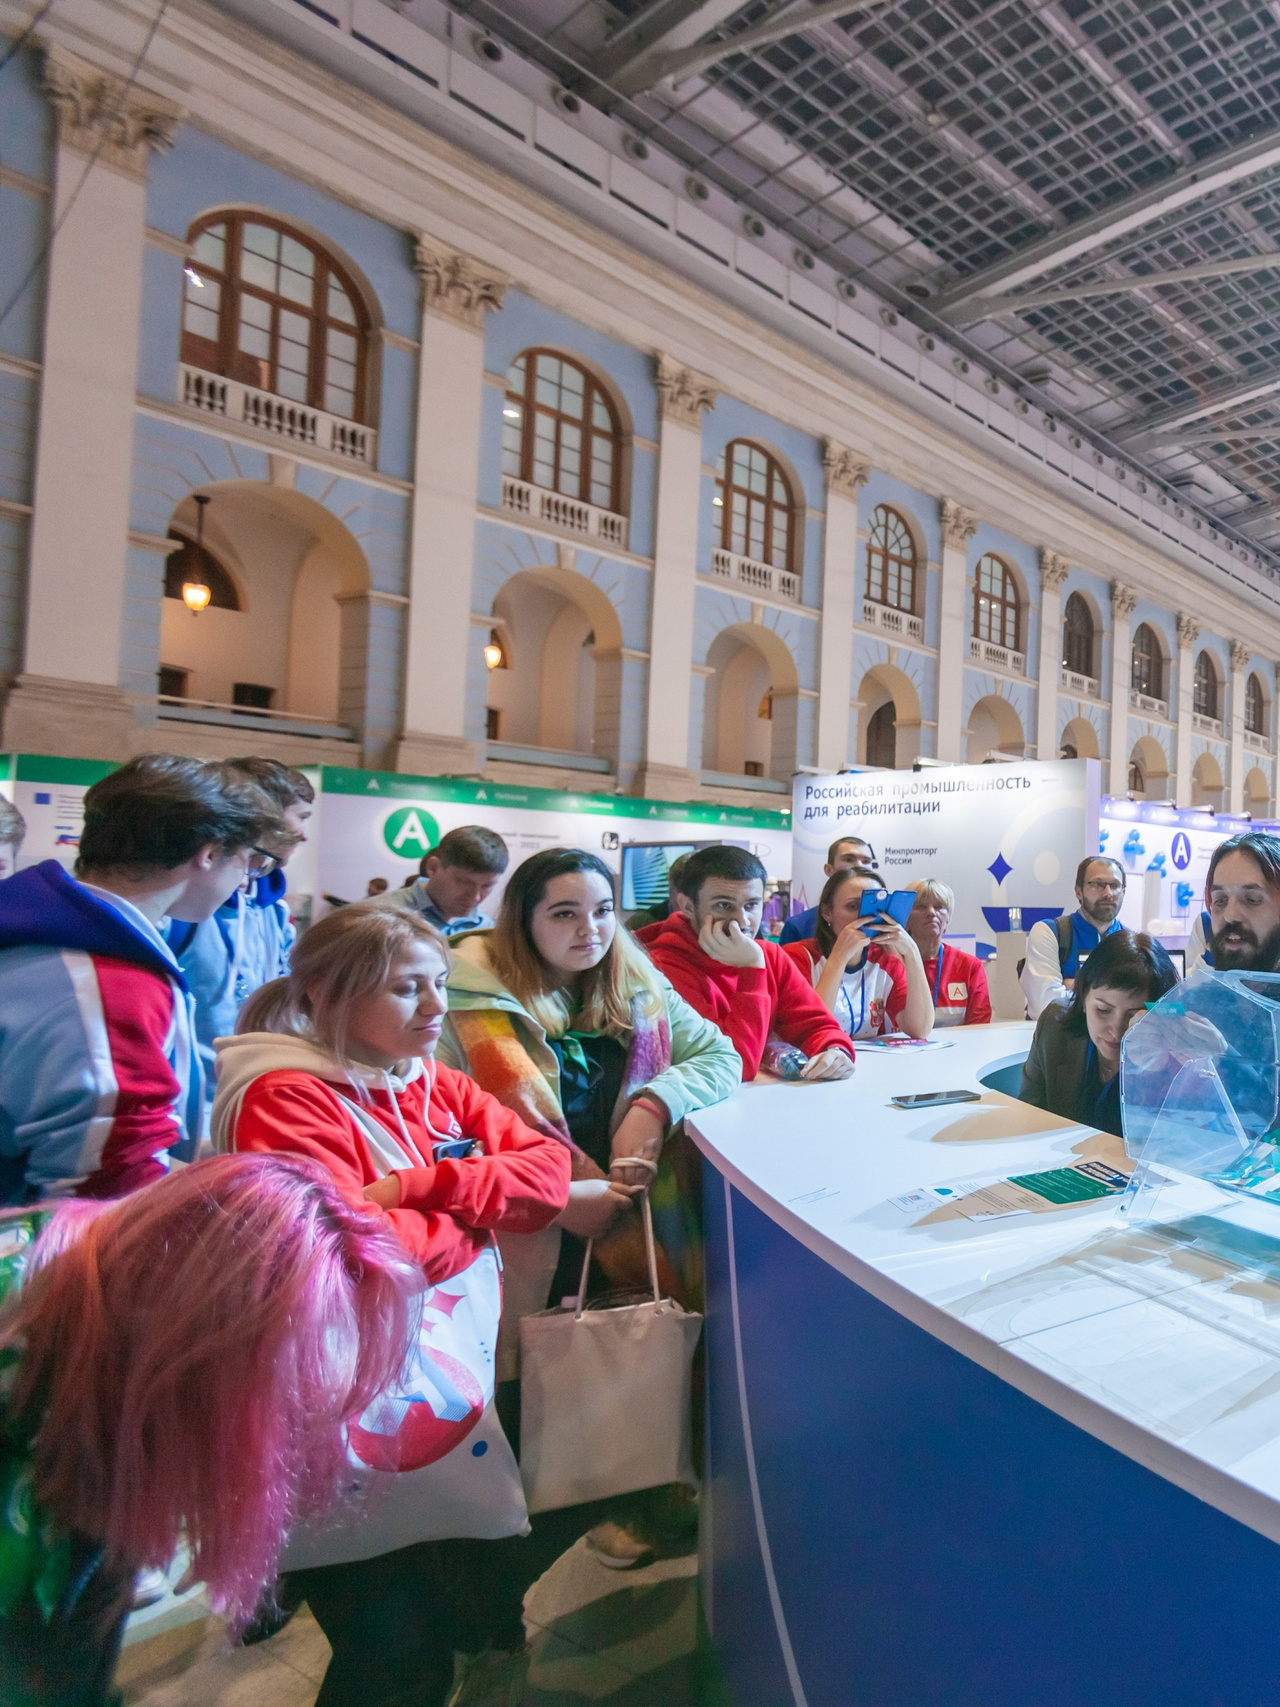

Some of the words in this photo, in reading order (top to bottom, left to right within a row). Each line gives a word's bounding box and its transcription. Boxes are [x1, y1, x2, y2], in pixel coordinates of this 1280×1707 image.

[806, 782, 884, 800] Российская
[892, 777, 1031, 799] промышленность
[804, 806, 829, 820] для
[837, 801, 940, 820] реабилитации
[885, 847, 938, 859] Минпромторг
[885, 857, 912, 865] России
